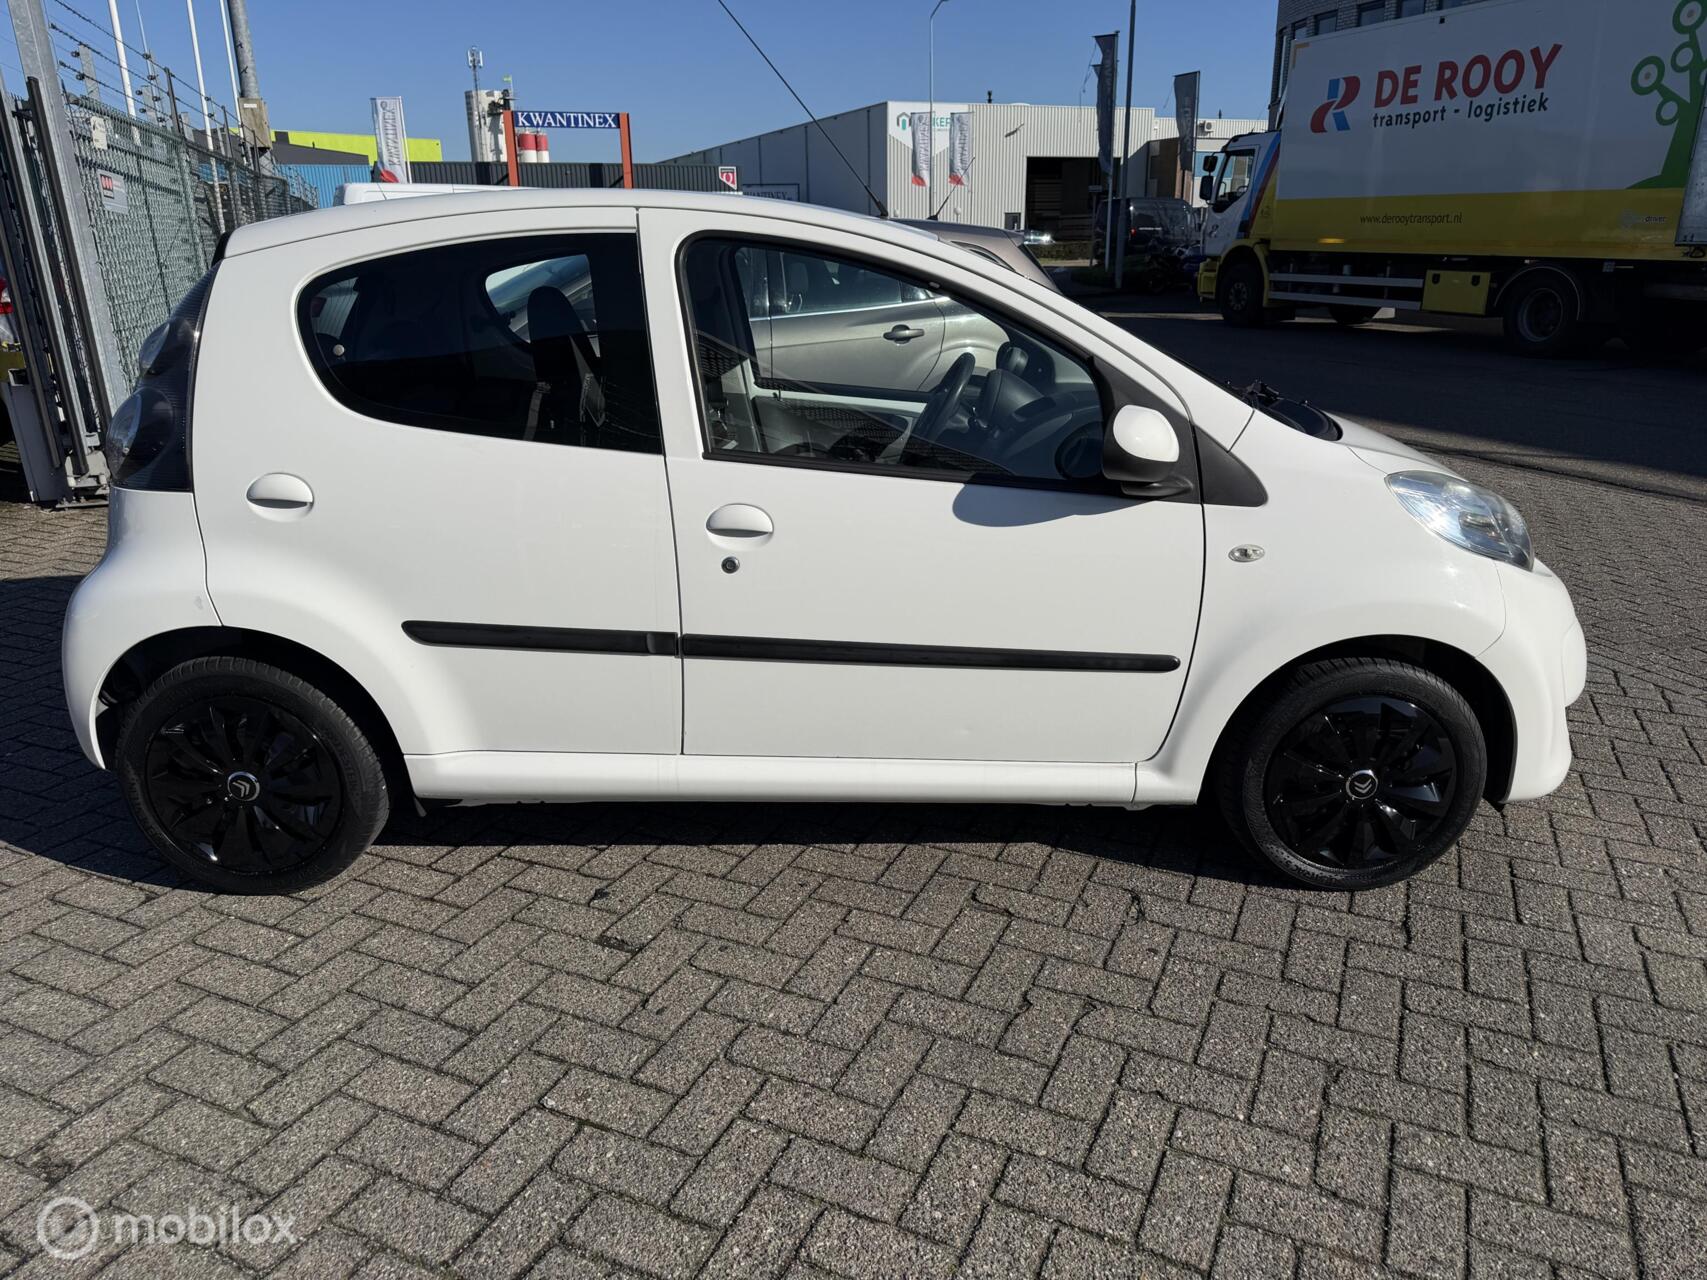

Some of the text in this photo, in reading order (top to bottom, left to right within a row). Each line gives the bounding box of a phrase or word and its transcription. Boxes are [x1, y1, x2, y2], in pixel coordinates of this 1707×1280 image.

[1374, 43, 1563, 108] DE ROOY
[517, 112, 617, 128] KWANTINEX
[1373, 105, 1446, 128] transport
[1468, 92, 1550, 122] logistiek
[1360, 211, 1463, 226] www.derooytransport.nl
